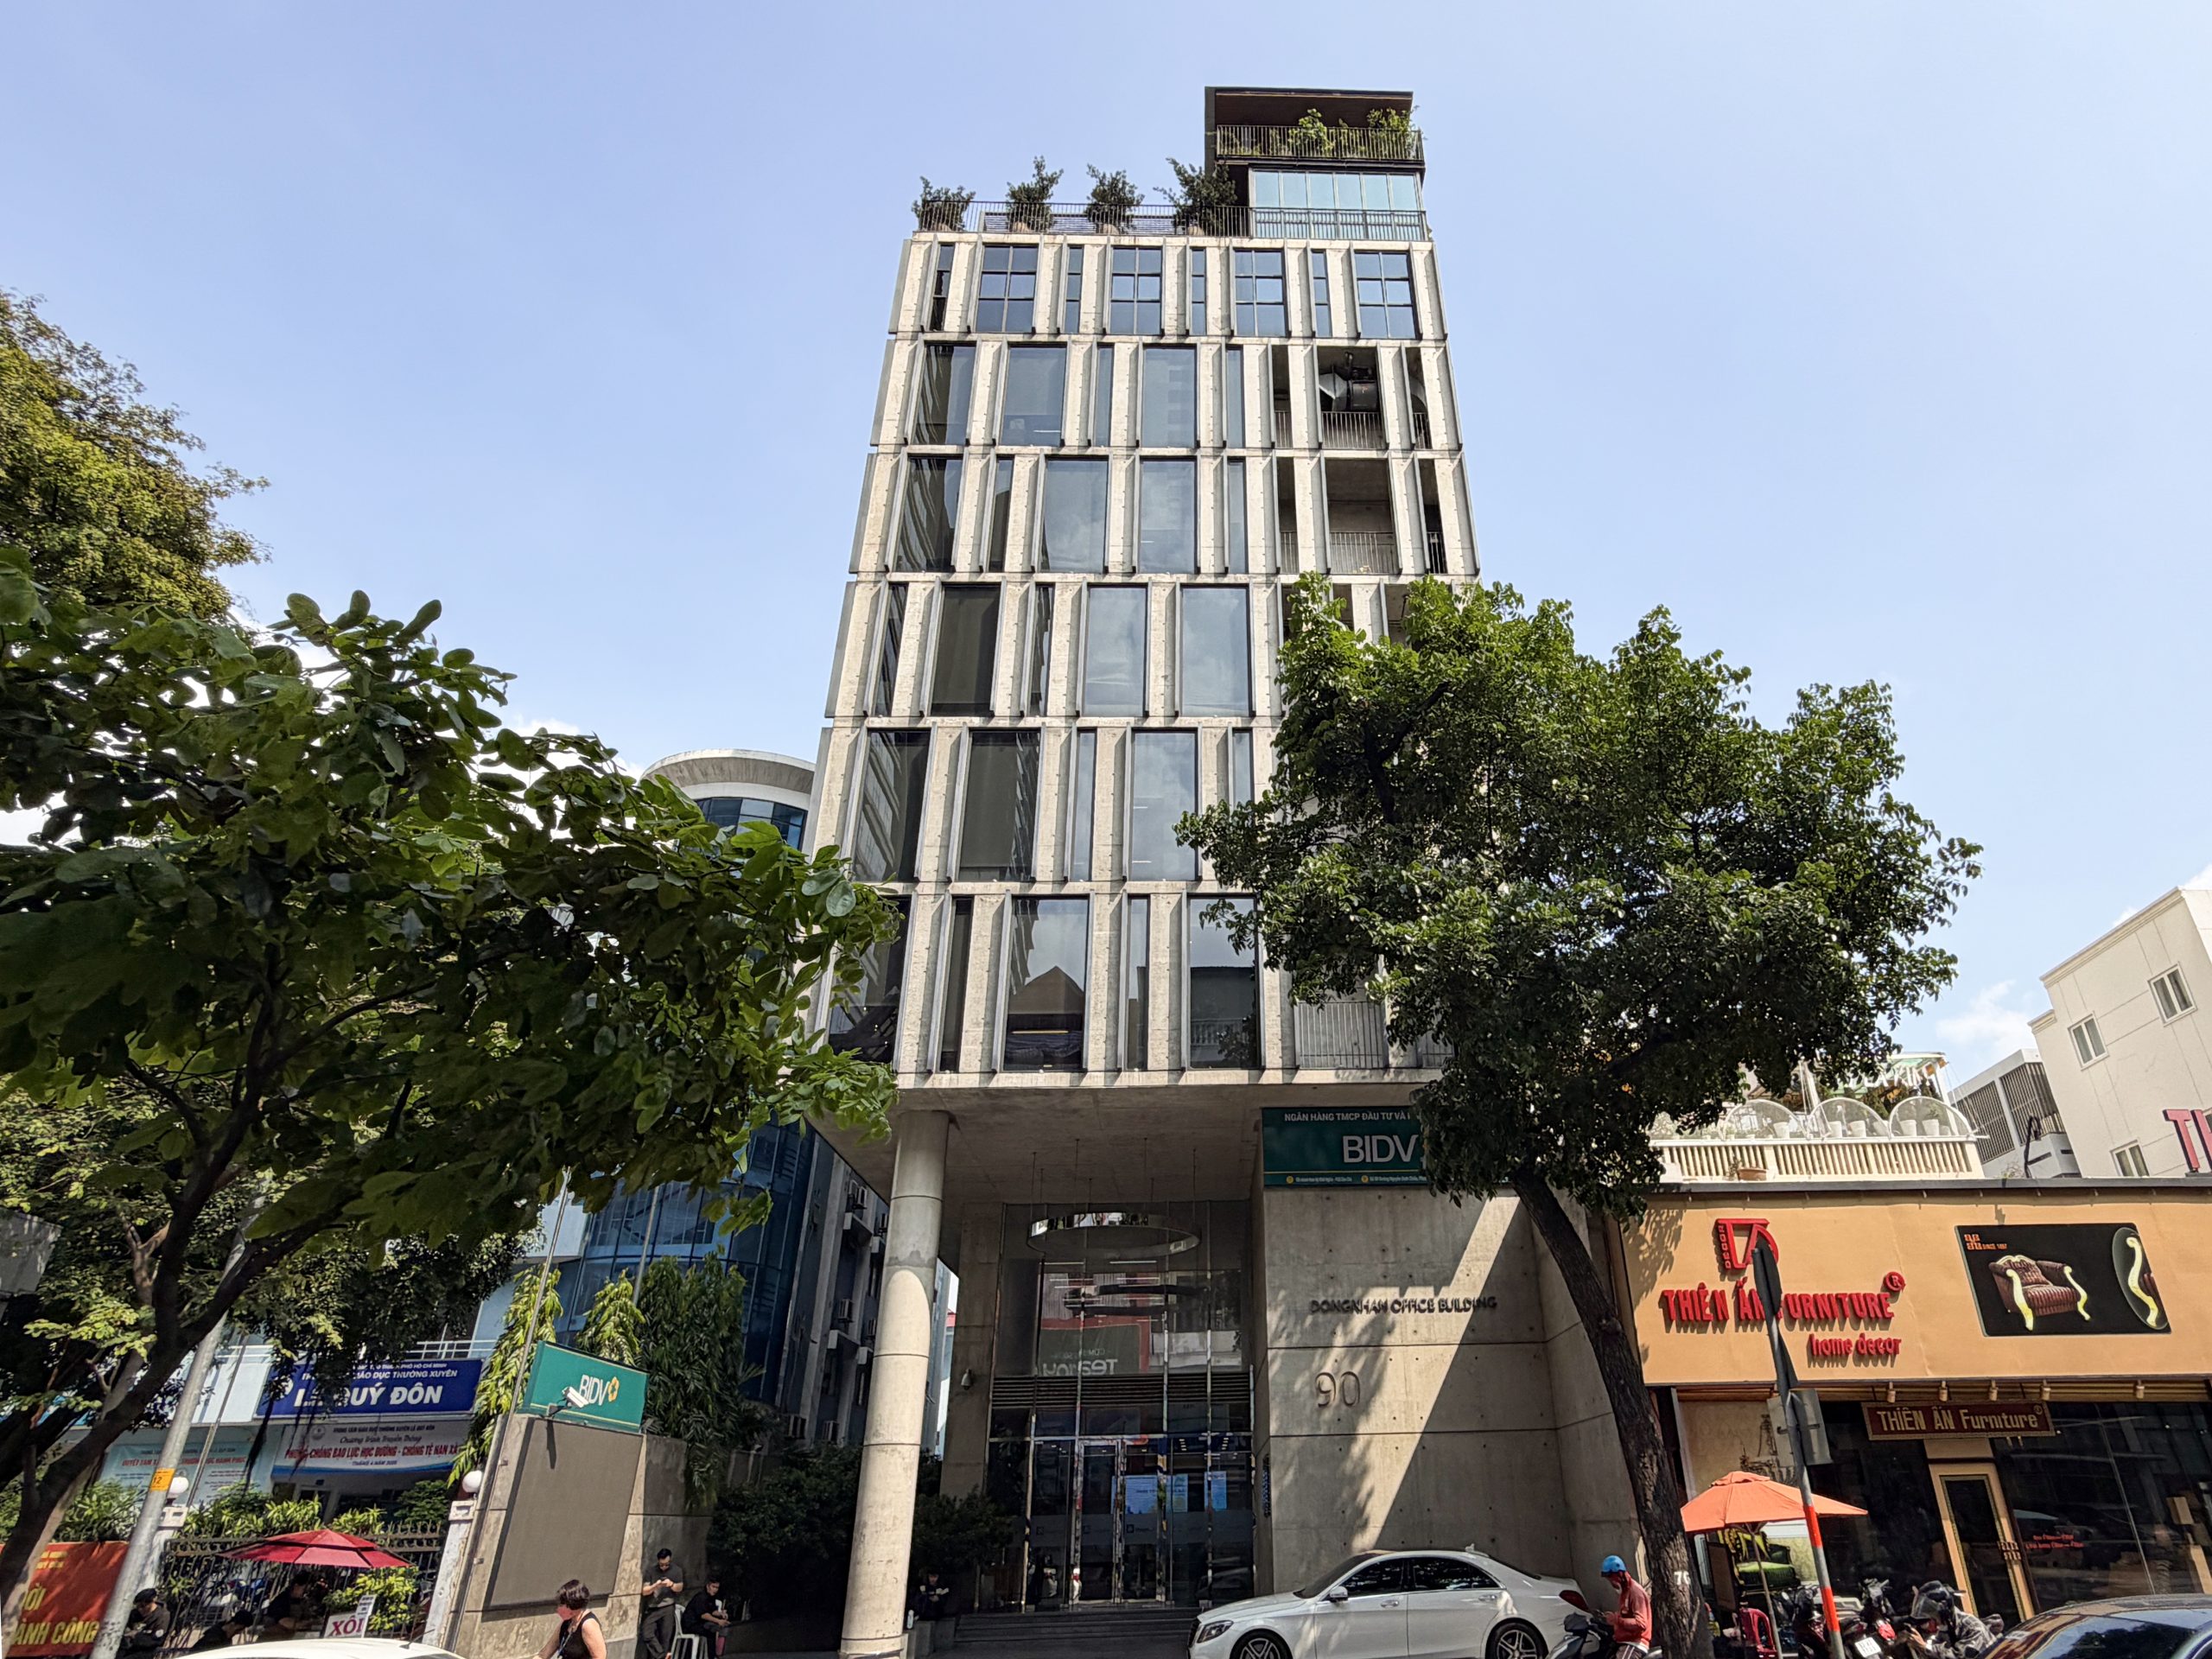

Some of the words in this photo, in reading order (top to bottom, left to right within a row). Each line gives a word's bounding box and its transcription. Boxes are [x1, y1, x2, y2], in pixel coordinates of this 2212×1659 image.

[1285, 1112, 1308, 1122] NGÂN
[1311, 1111, 1334, 1122] HÀNG
[1362, 1110, 1379, 1121] ĐẦU
[1381, 1111, 1393, 1121] TƯ
[1394, 1109, 1406, 1120] VÀ
[1342, 1135, 1419, 1163] BIDV
[1390, 1298, 1435, 1313] OFFICE
[1438, 1296, 1497, 1313] BUILDING
[1660, 1282, 1730, 1321] THIÊN
[1776, 1293, 1895, 1319] URNITURE
[1809, 1333, 1853, 1356] home
[1855, 1332, 1902, 1355] decor
[372, 1370, 391, 1380] DỤC
[392, 1369, 429, 1378] THƯỜNG
[429, 1368, 458, 1377] XUYÊN
[390, 1382, 443, 1405] ĐÔN
[579, 1374, 610, 1406] BIDV
[1314, 1370, 1361, 1408] 90
[1959, 1408, 2038, 1429] Furniture
[51, 1617, 100, 1645] CÔNG
[329, 1615, 365, 1637] XÔI
